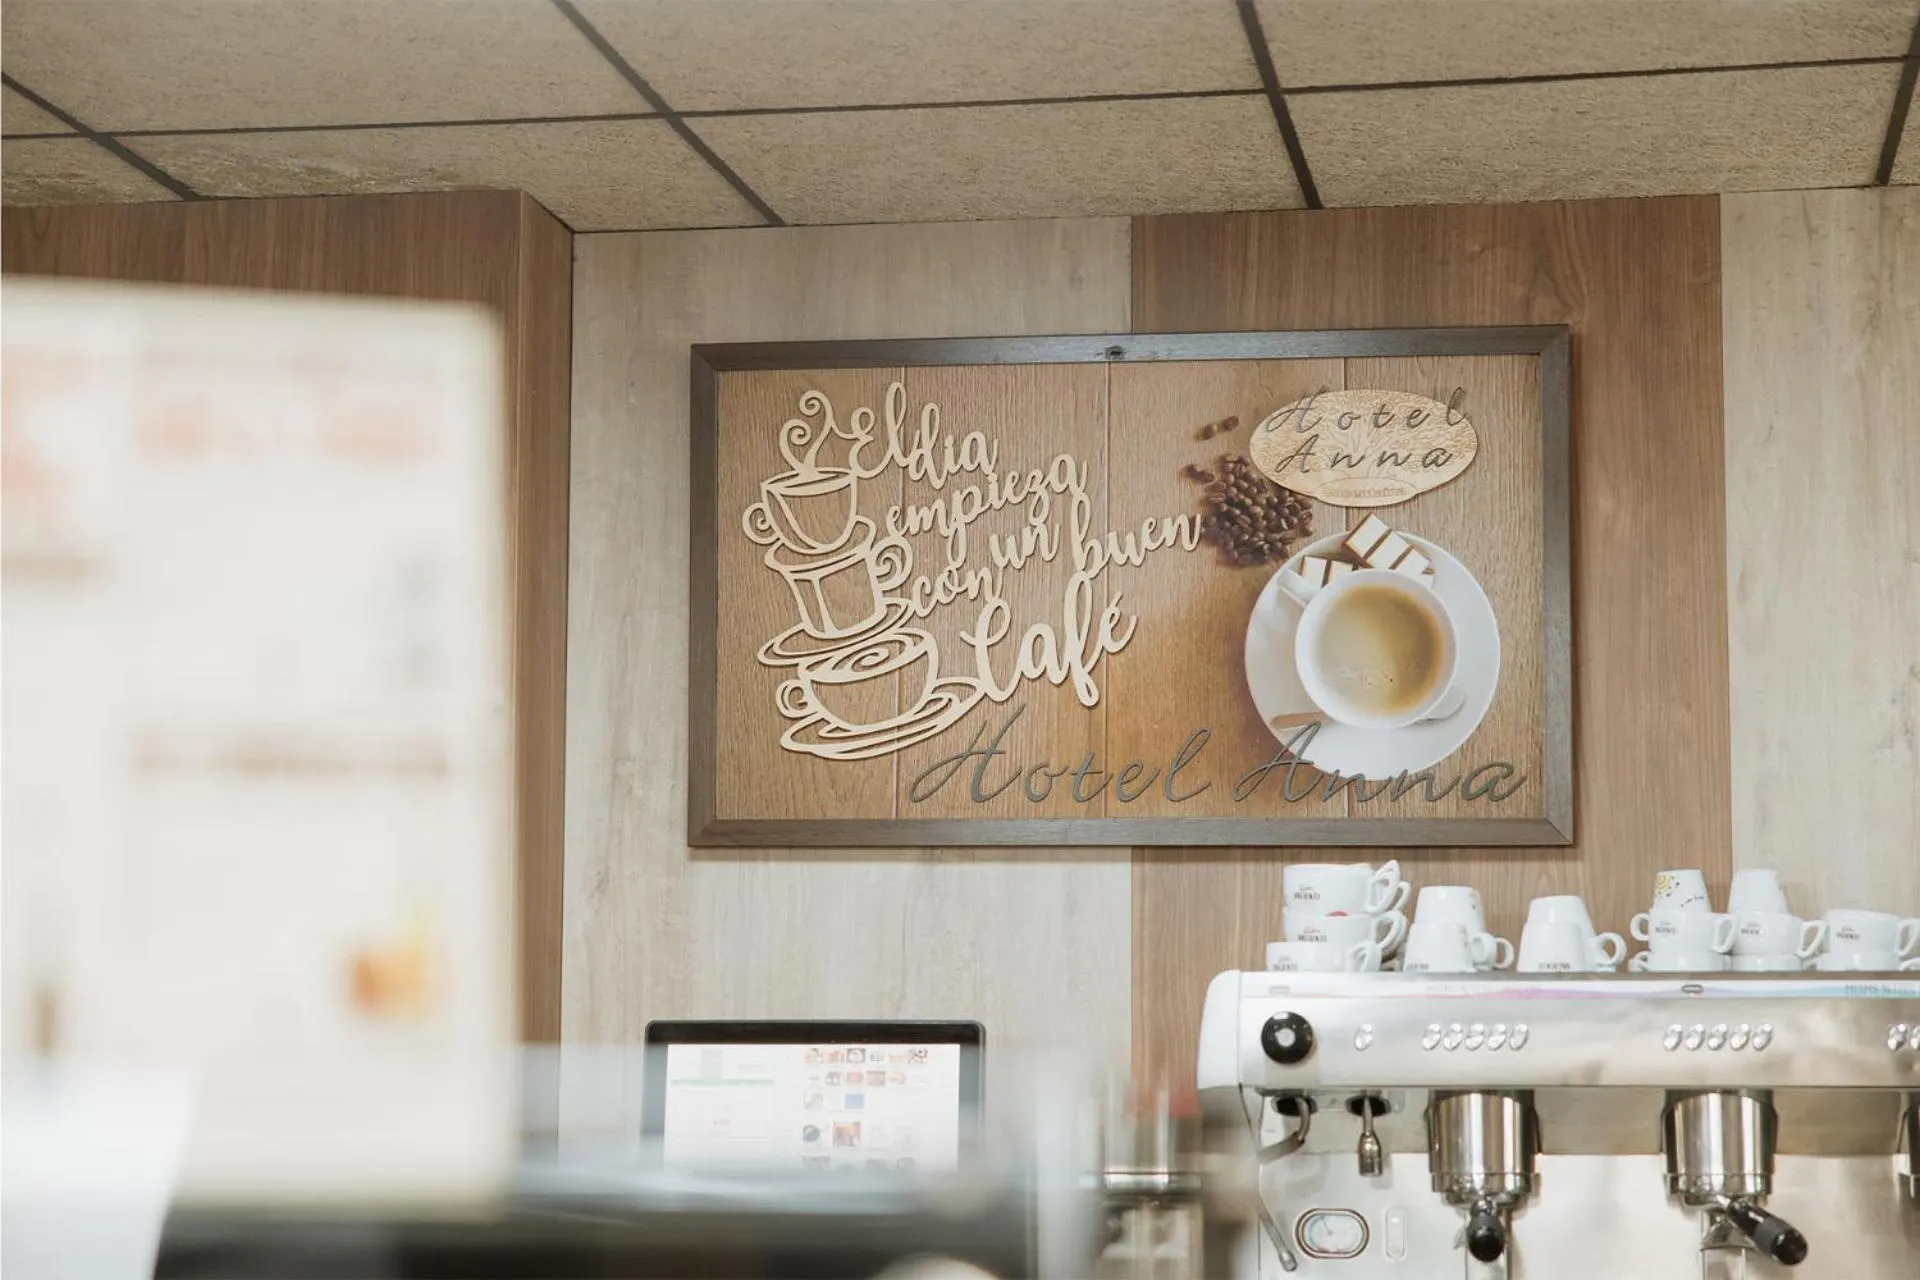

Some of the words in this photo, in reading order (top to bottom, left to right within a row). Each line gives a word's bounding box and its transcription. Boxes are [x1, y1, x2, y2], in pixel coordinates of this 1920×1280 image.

[849, 382, 916, 479] El
[1266, 385, 1469, 433] Hotel
[1275, 434, 1453, 474] Anna
[886, 454, 1088, 570] empieza
[911, 567, 1003, 617] con
[989, 522, 1060, 569] un
[1071, 497, 1201, 579] buen
[960, 571, 1137, 707] Café
[910, 703, 1211, 803] Hotel
[1234, 722, 1527, 803] Anna
